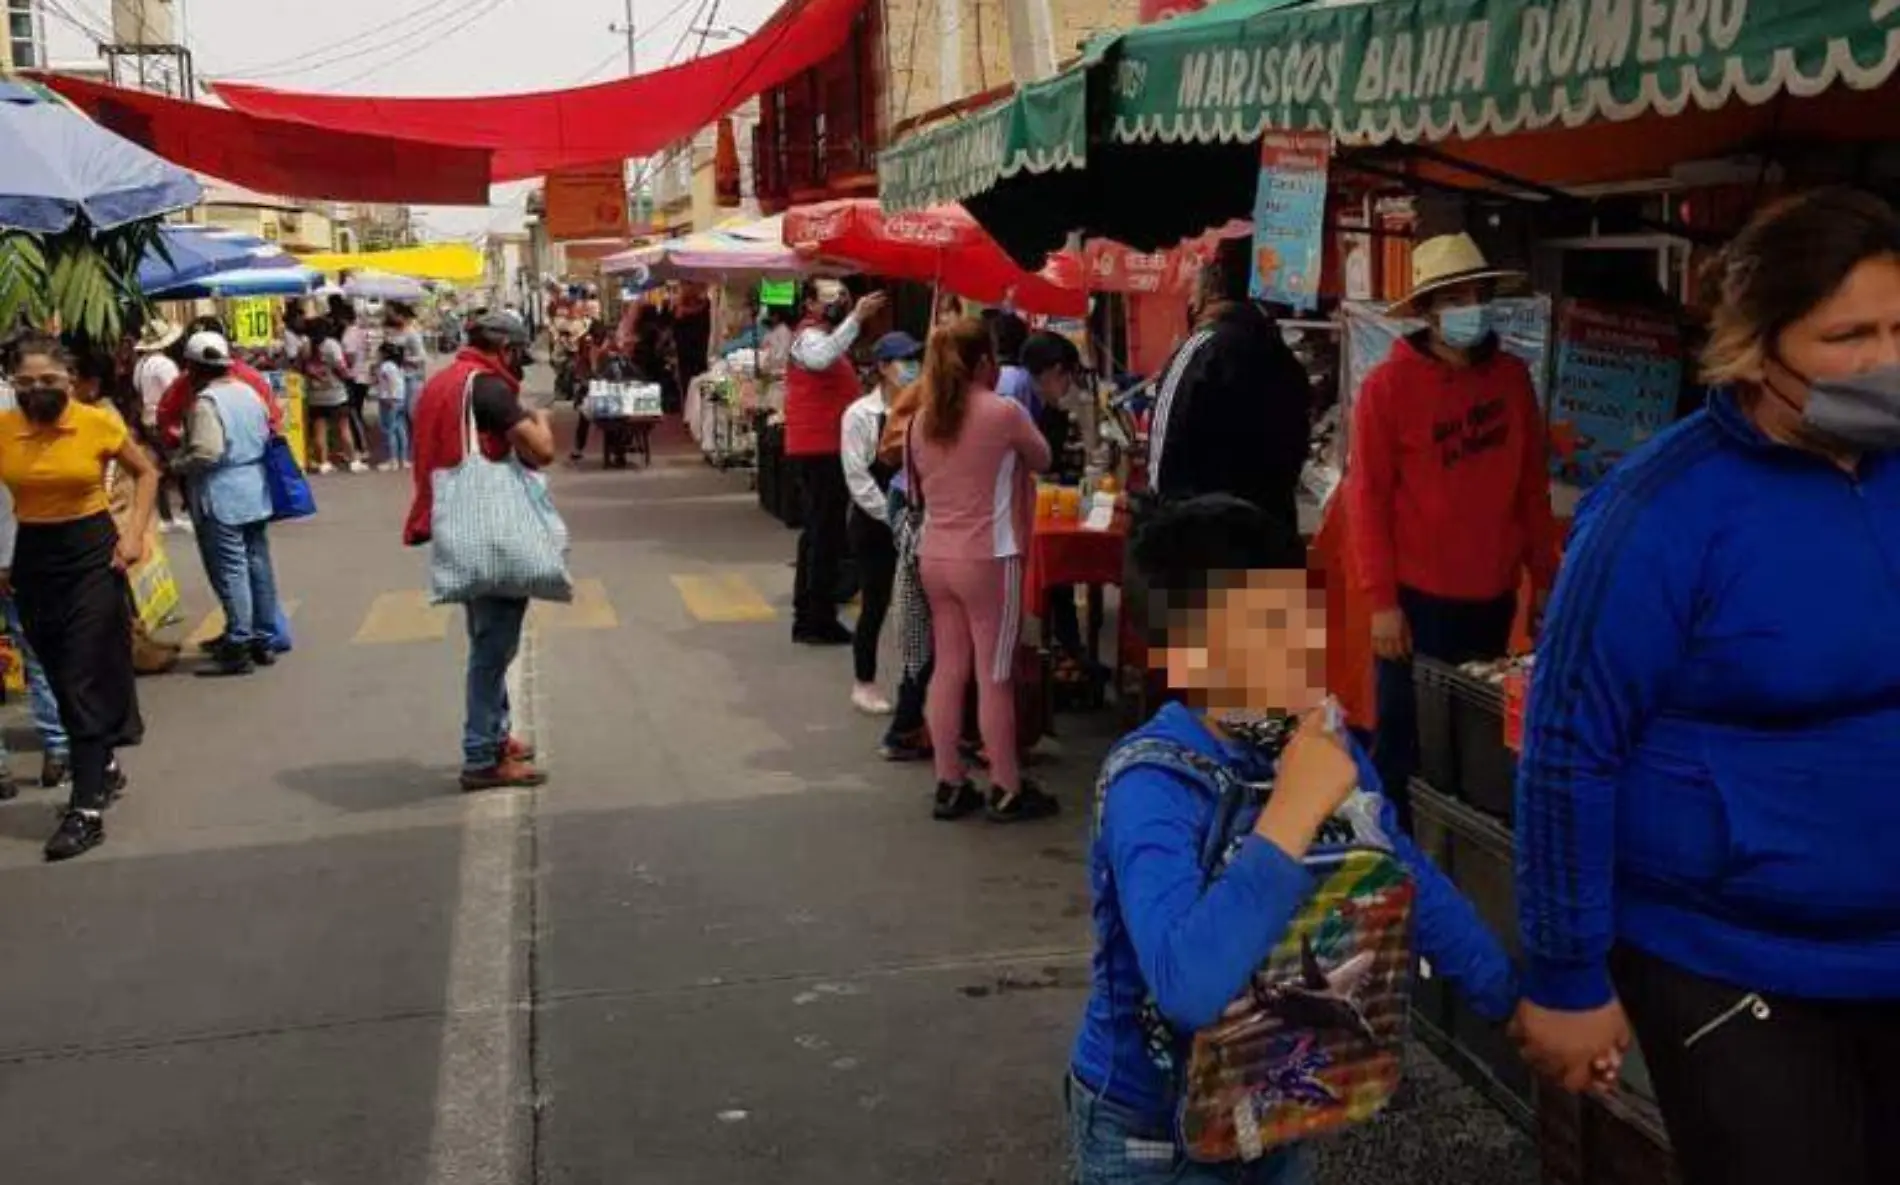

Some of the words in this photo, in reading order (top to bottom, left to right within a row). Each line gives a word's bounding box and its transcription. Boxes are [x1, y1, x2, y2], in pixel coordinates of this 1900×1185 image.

[1178, 46, 1344, 107] MARISCOS
[1355, 21, 1489, 101] BAHIA
[1514, 0, 1745, 86] ROMERO
